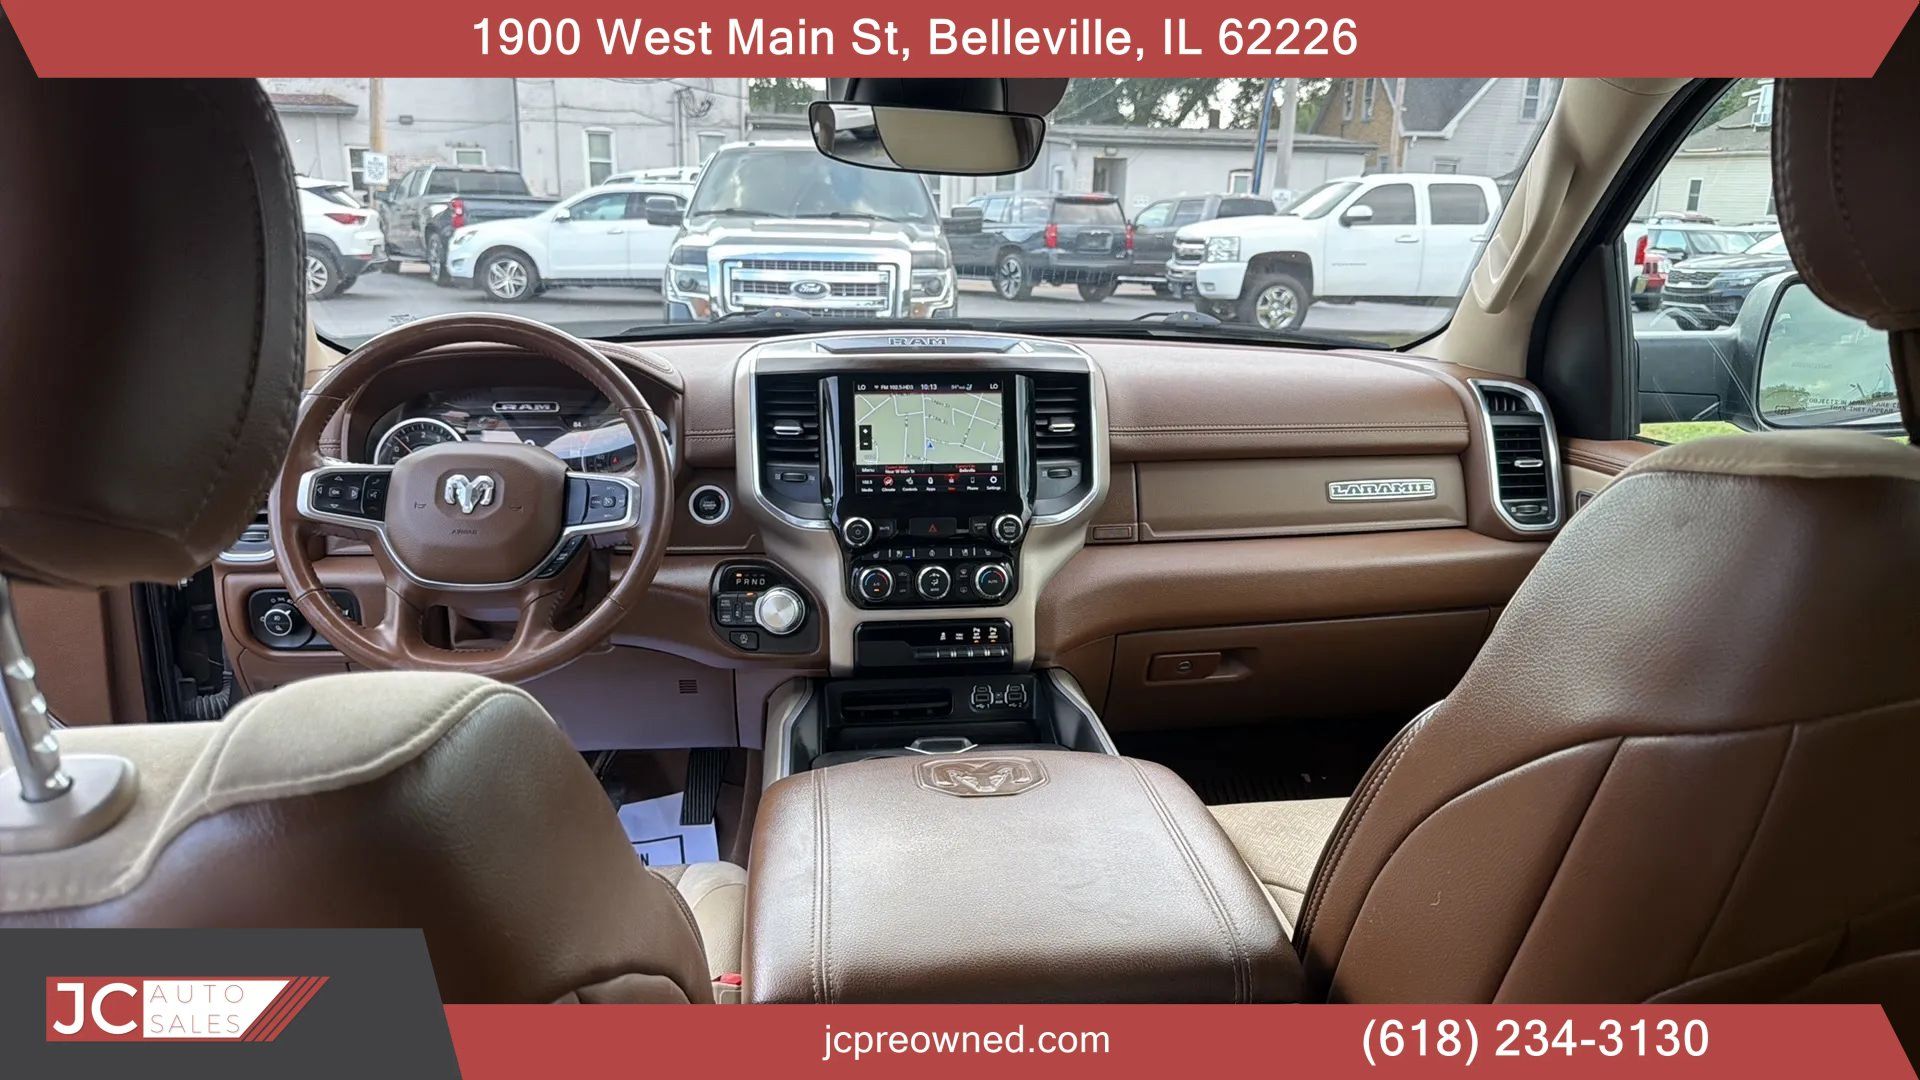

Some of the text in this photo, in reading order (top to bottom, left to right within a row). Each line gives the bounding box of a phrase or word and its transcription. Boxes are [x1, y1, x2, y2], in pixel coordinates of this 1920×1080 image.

[798, 283, 821, 294] Ford
[888, 336, 948, 346] RAM
[920, 383, 938, 391] 10:13
[1332, 483, 1432, 495] LARAMIE
